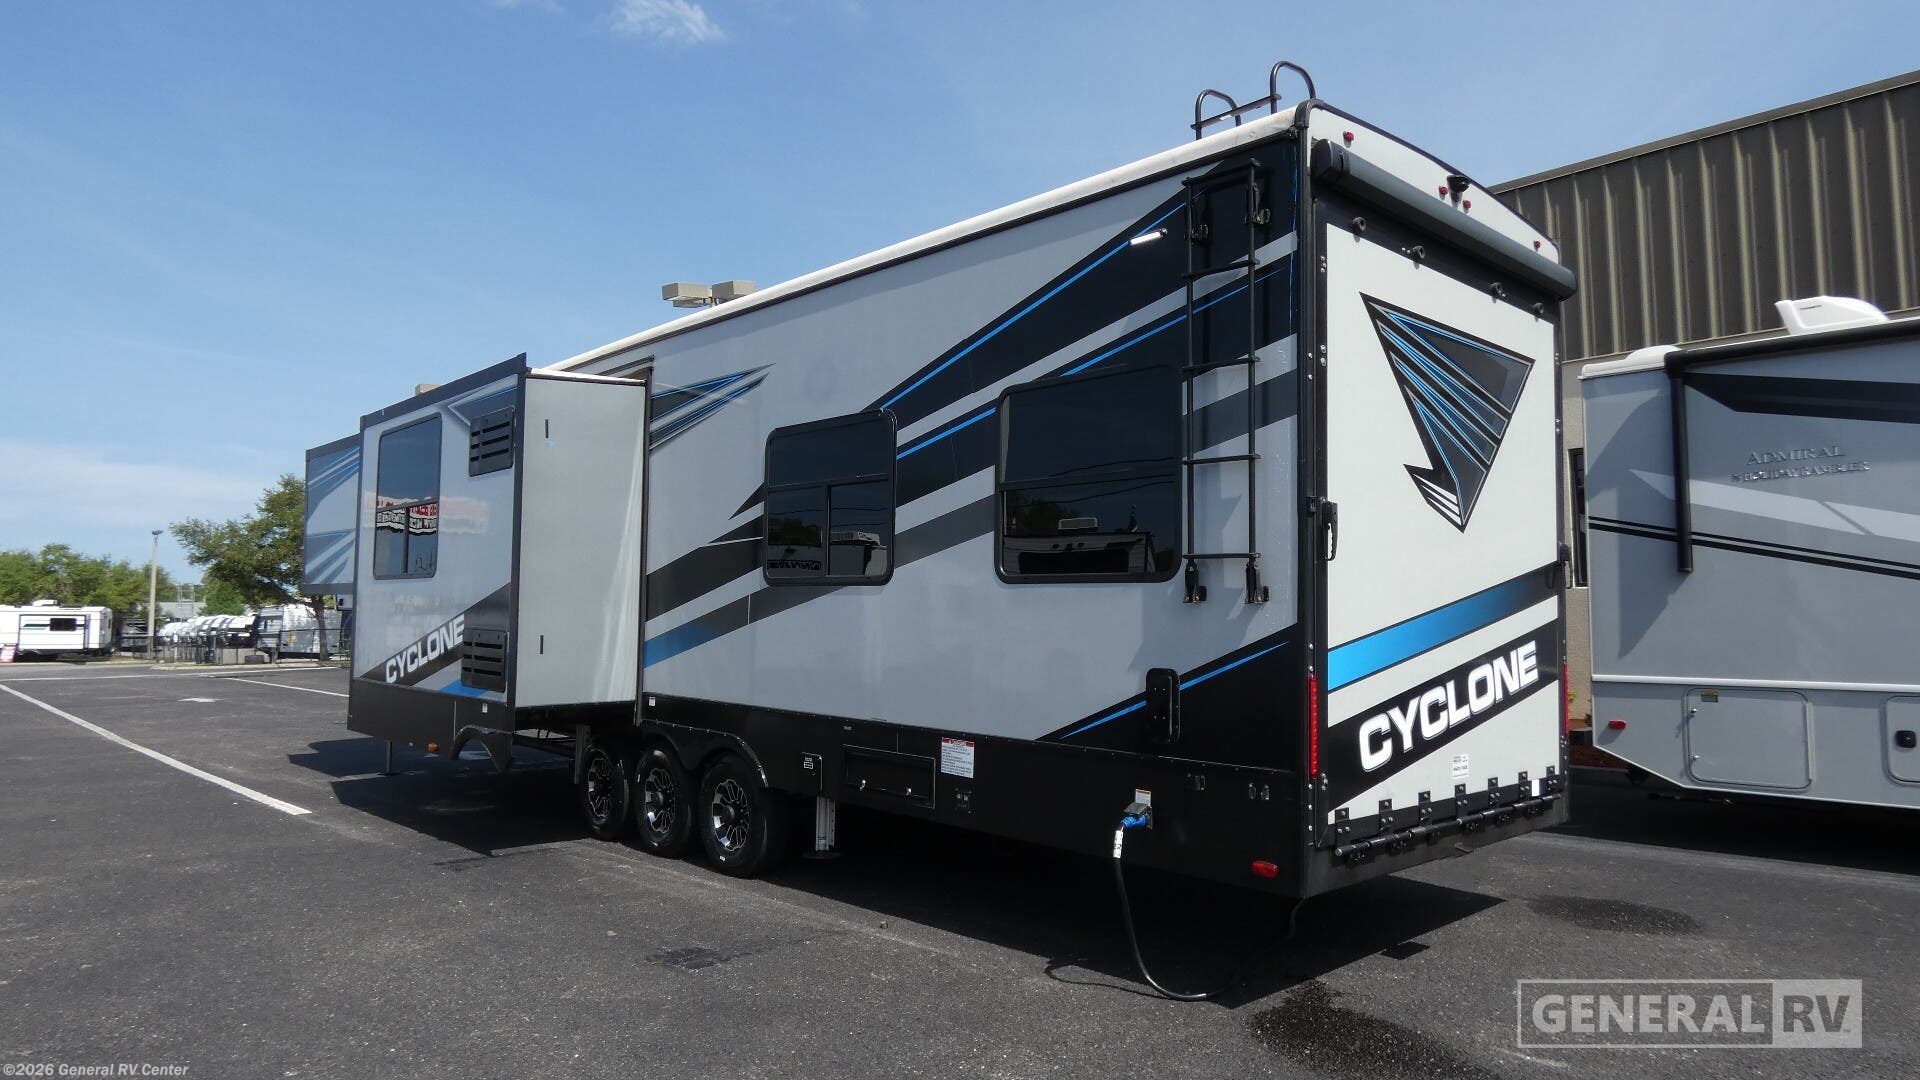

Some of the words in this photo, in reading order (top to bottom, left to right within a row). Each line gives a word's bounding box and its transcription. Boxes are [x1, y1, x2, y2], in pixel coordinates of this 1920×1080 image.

[1746, 446, 1845, 466] ADMIRAL
[385, 613, 465, 684] CYCLONE
[1359, 640, 1539, 773] CYCLONE
